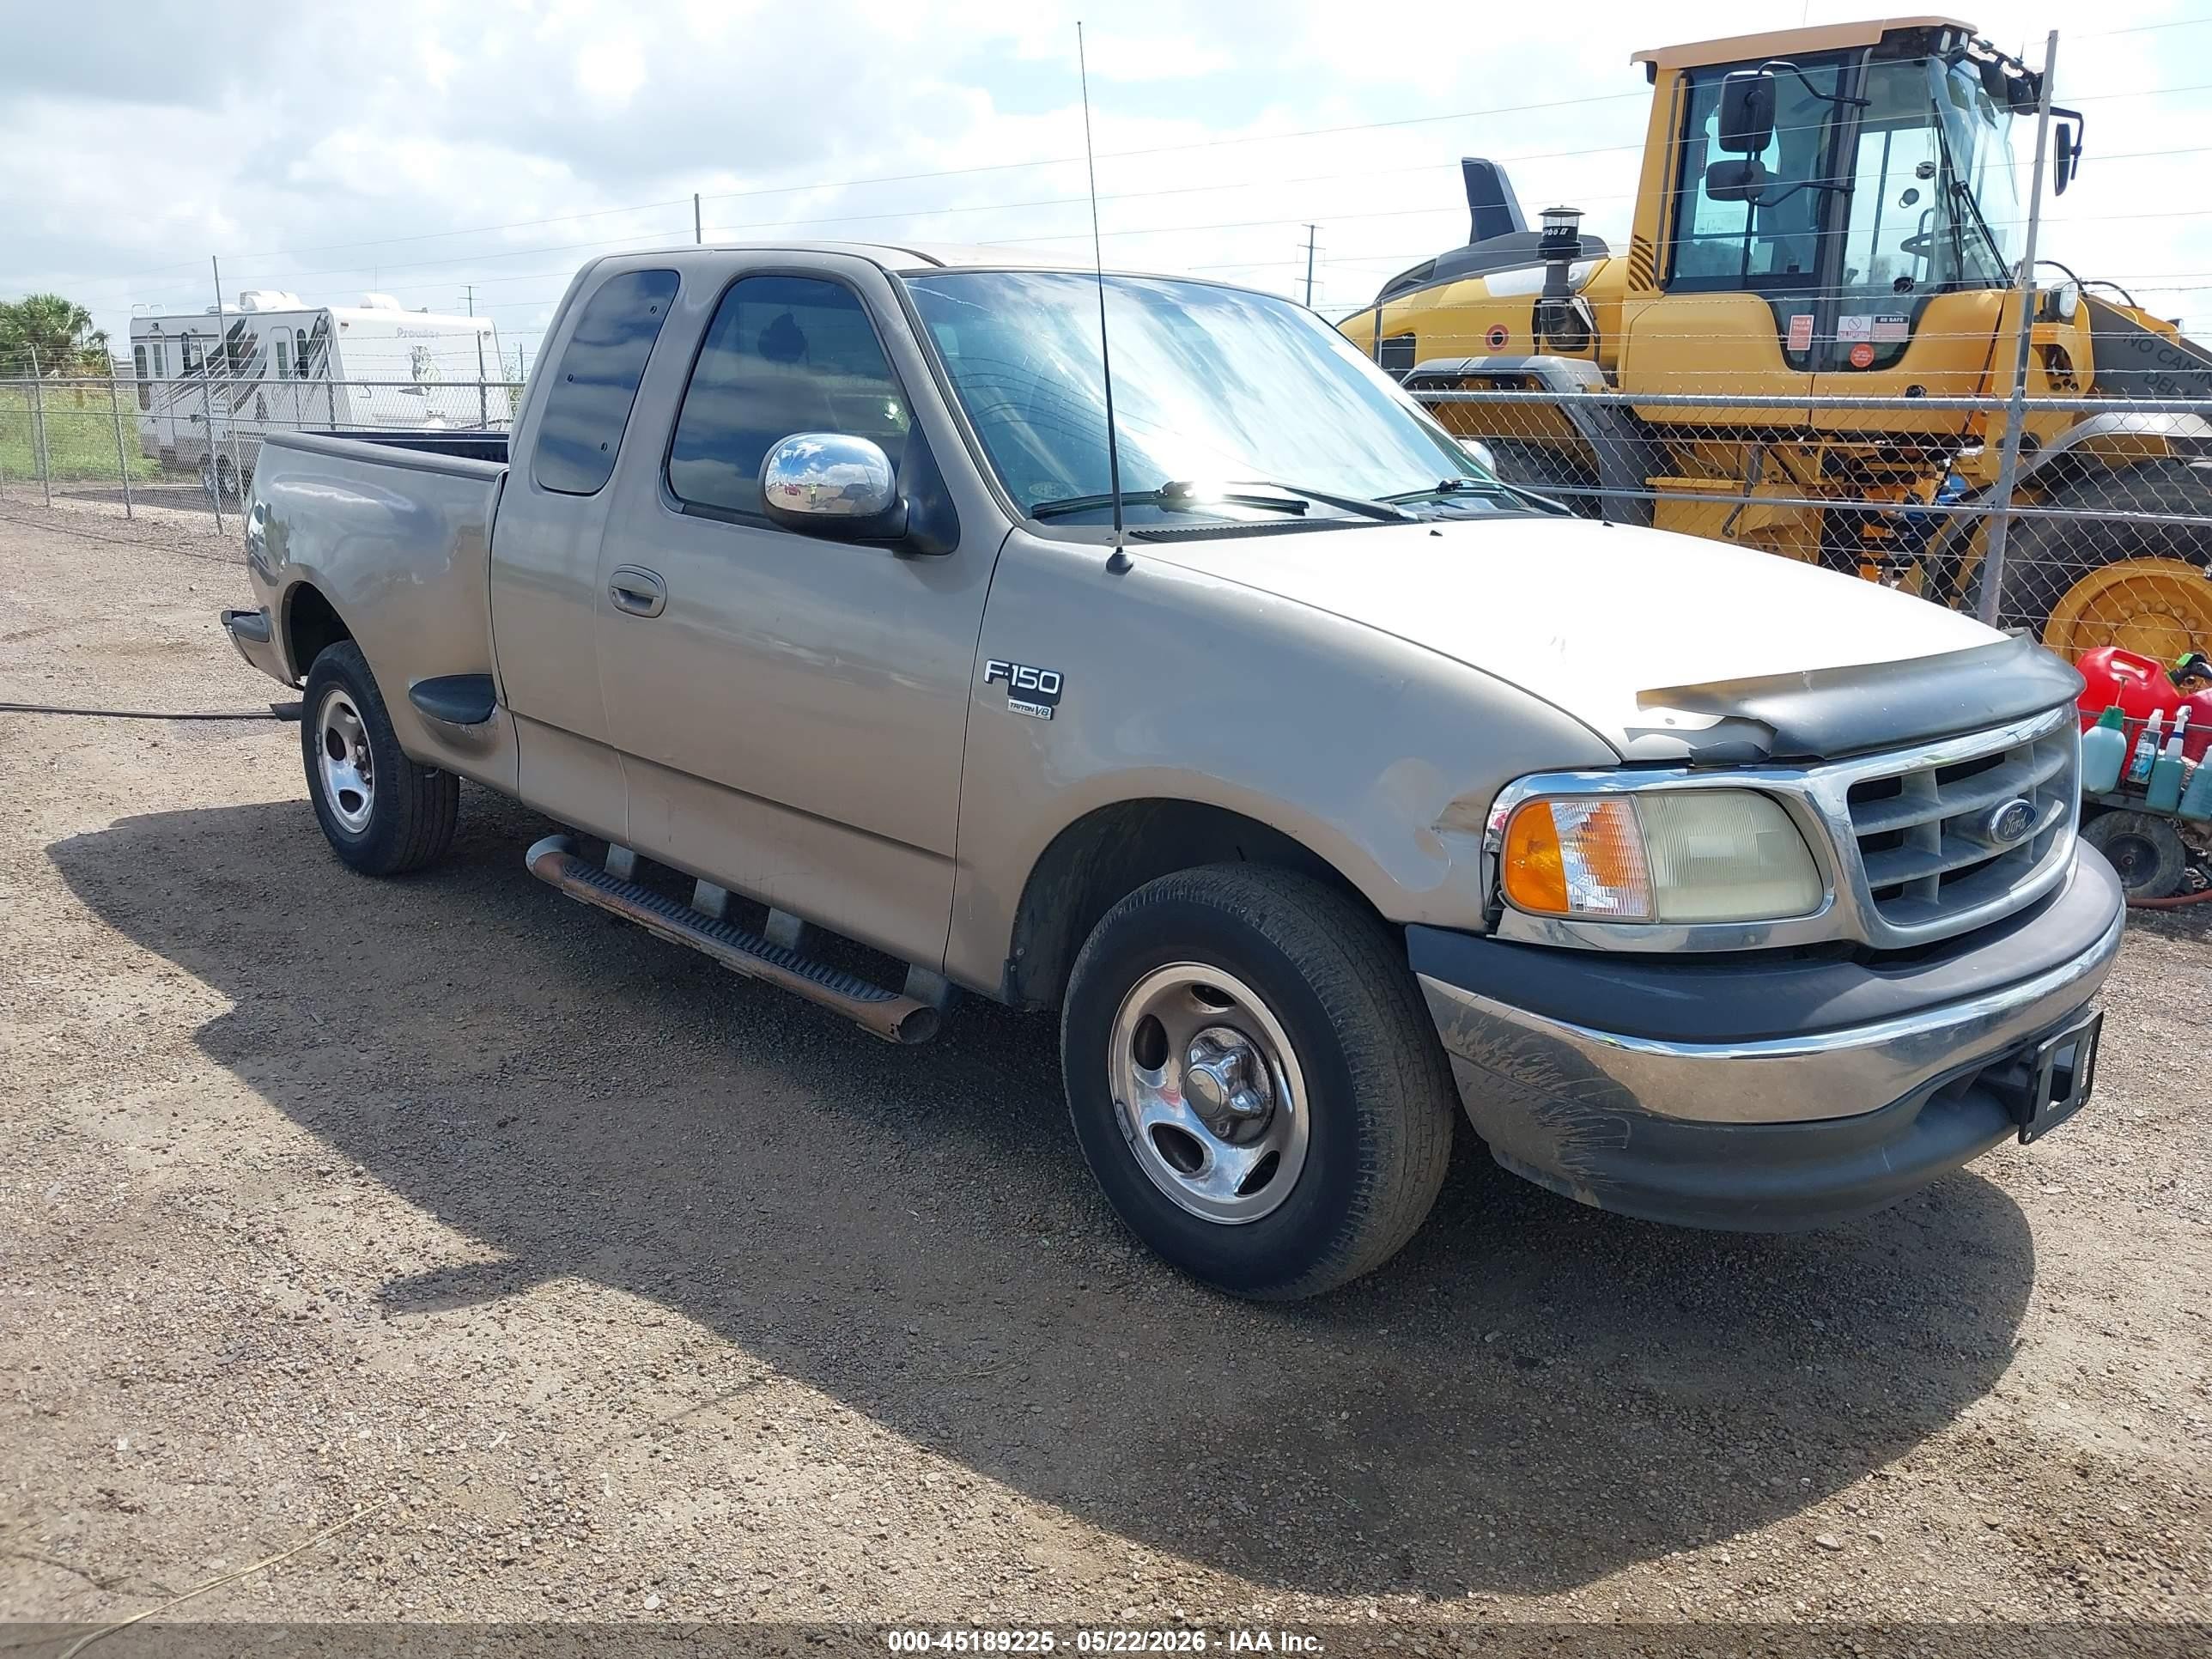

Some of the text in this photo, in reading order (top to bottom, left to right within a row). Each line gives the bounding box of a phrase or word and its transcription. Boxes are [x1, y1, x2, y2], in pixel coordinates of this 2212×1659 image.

[1009, 702, 1049, 716] TRITON V8
[2004, 806, 2027, 836] Ford
